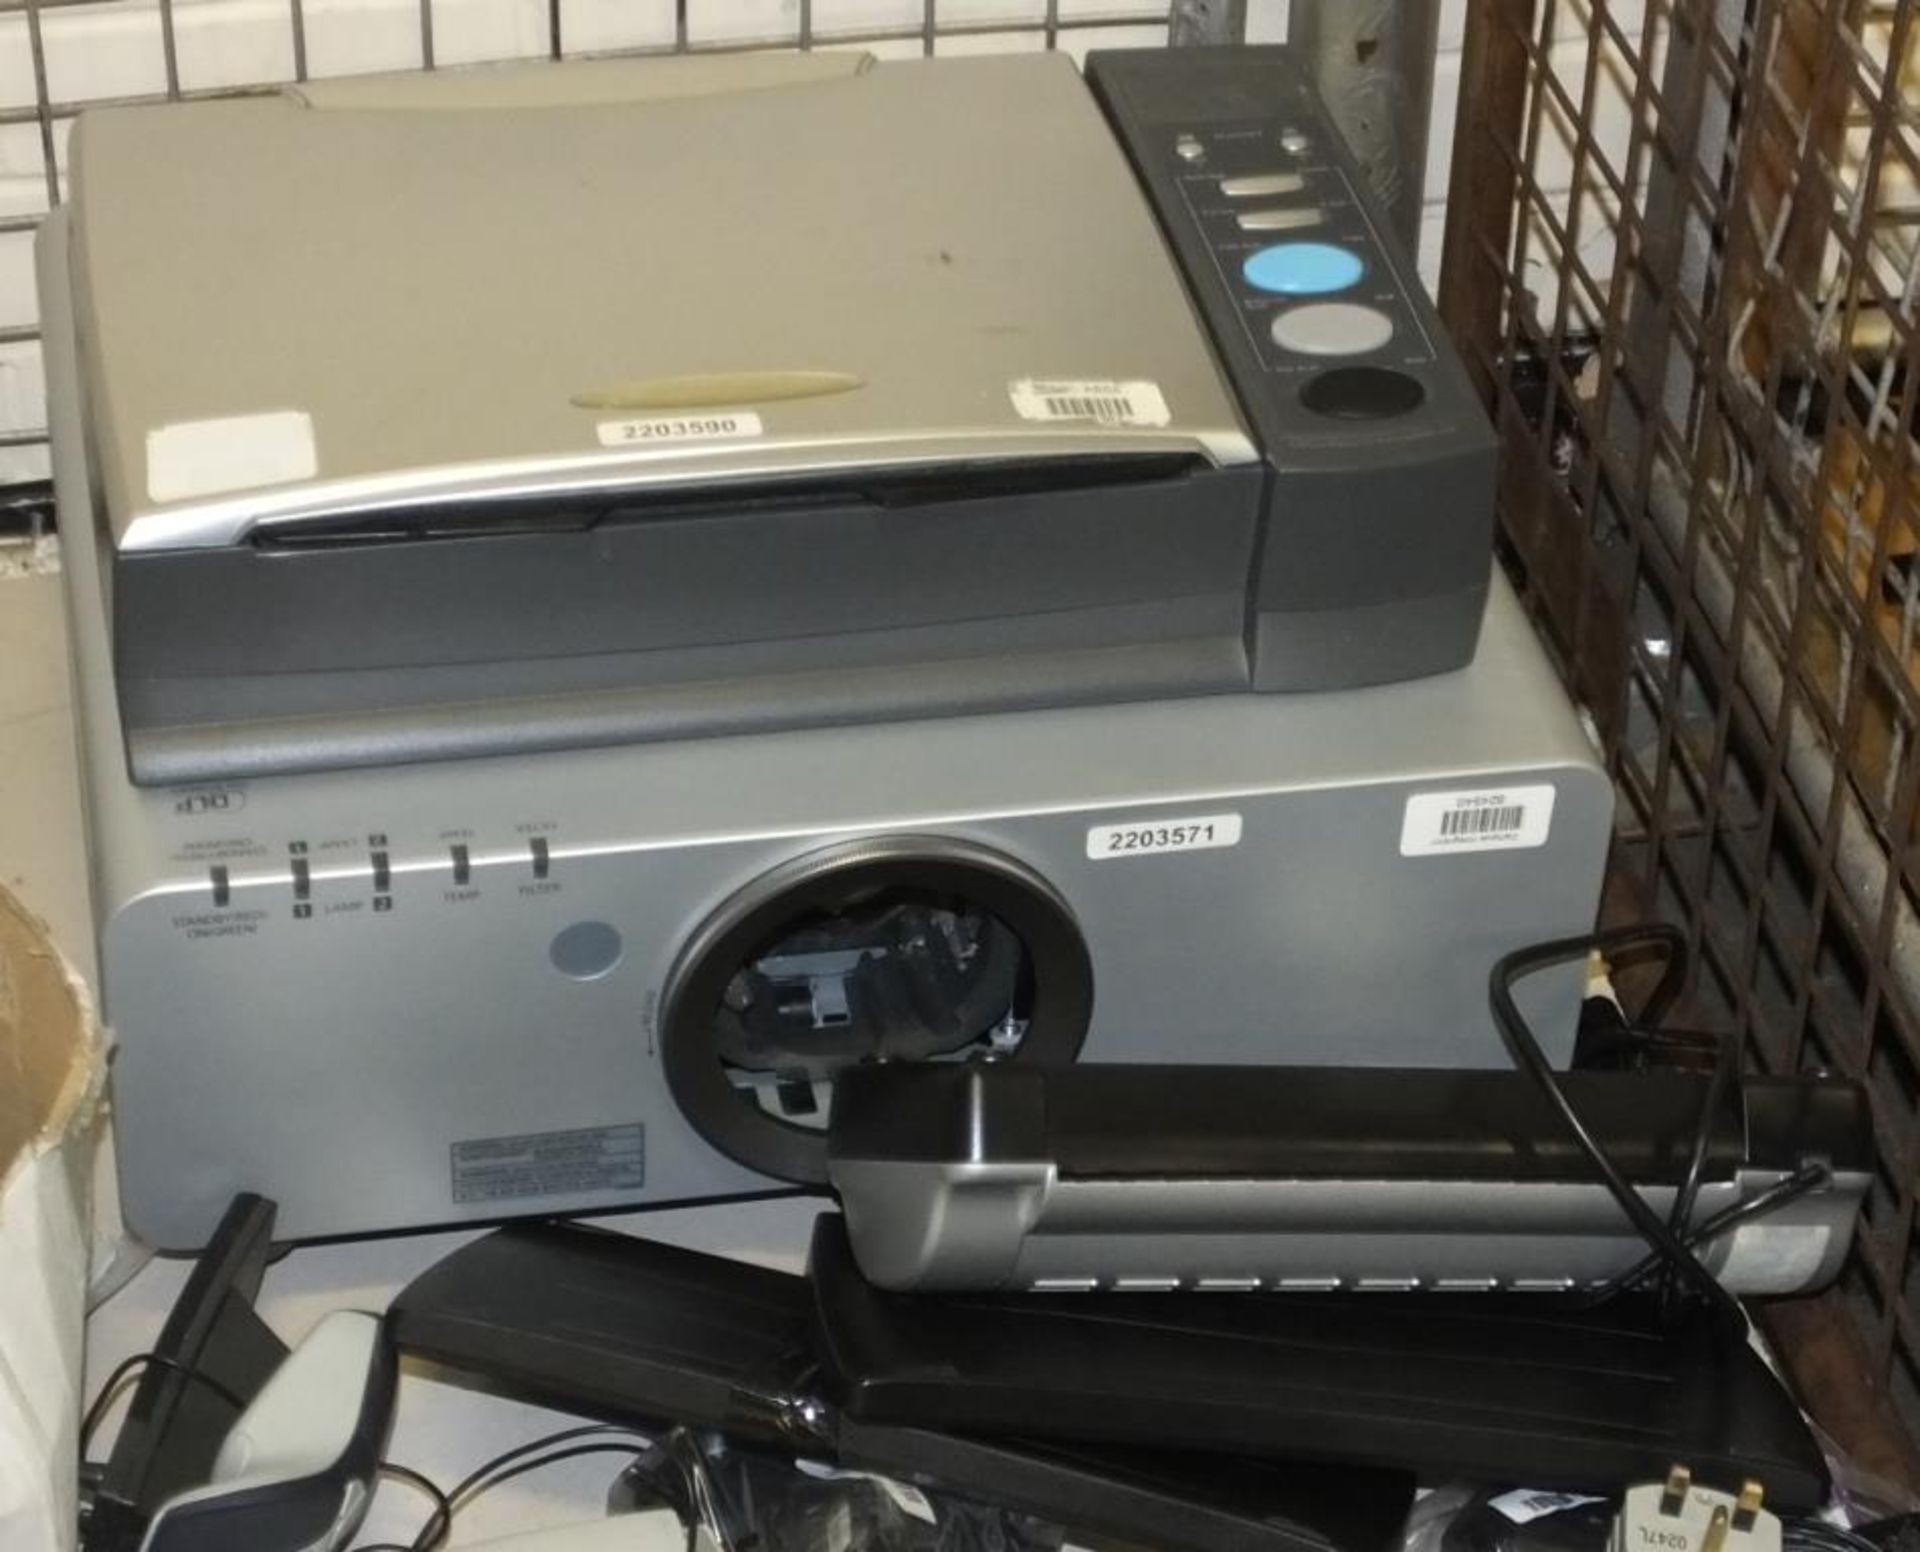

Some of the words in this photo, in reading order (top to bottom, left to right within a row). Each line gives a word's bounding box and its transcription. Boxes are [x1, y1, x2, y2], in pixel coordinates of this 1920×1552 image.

[622, 419, 737, 439] 2203590
[1108, 824, 1214, 850] 2203571
[1639, 1526, 1687, 1550] 0247L
